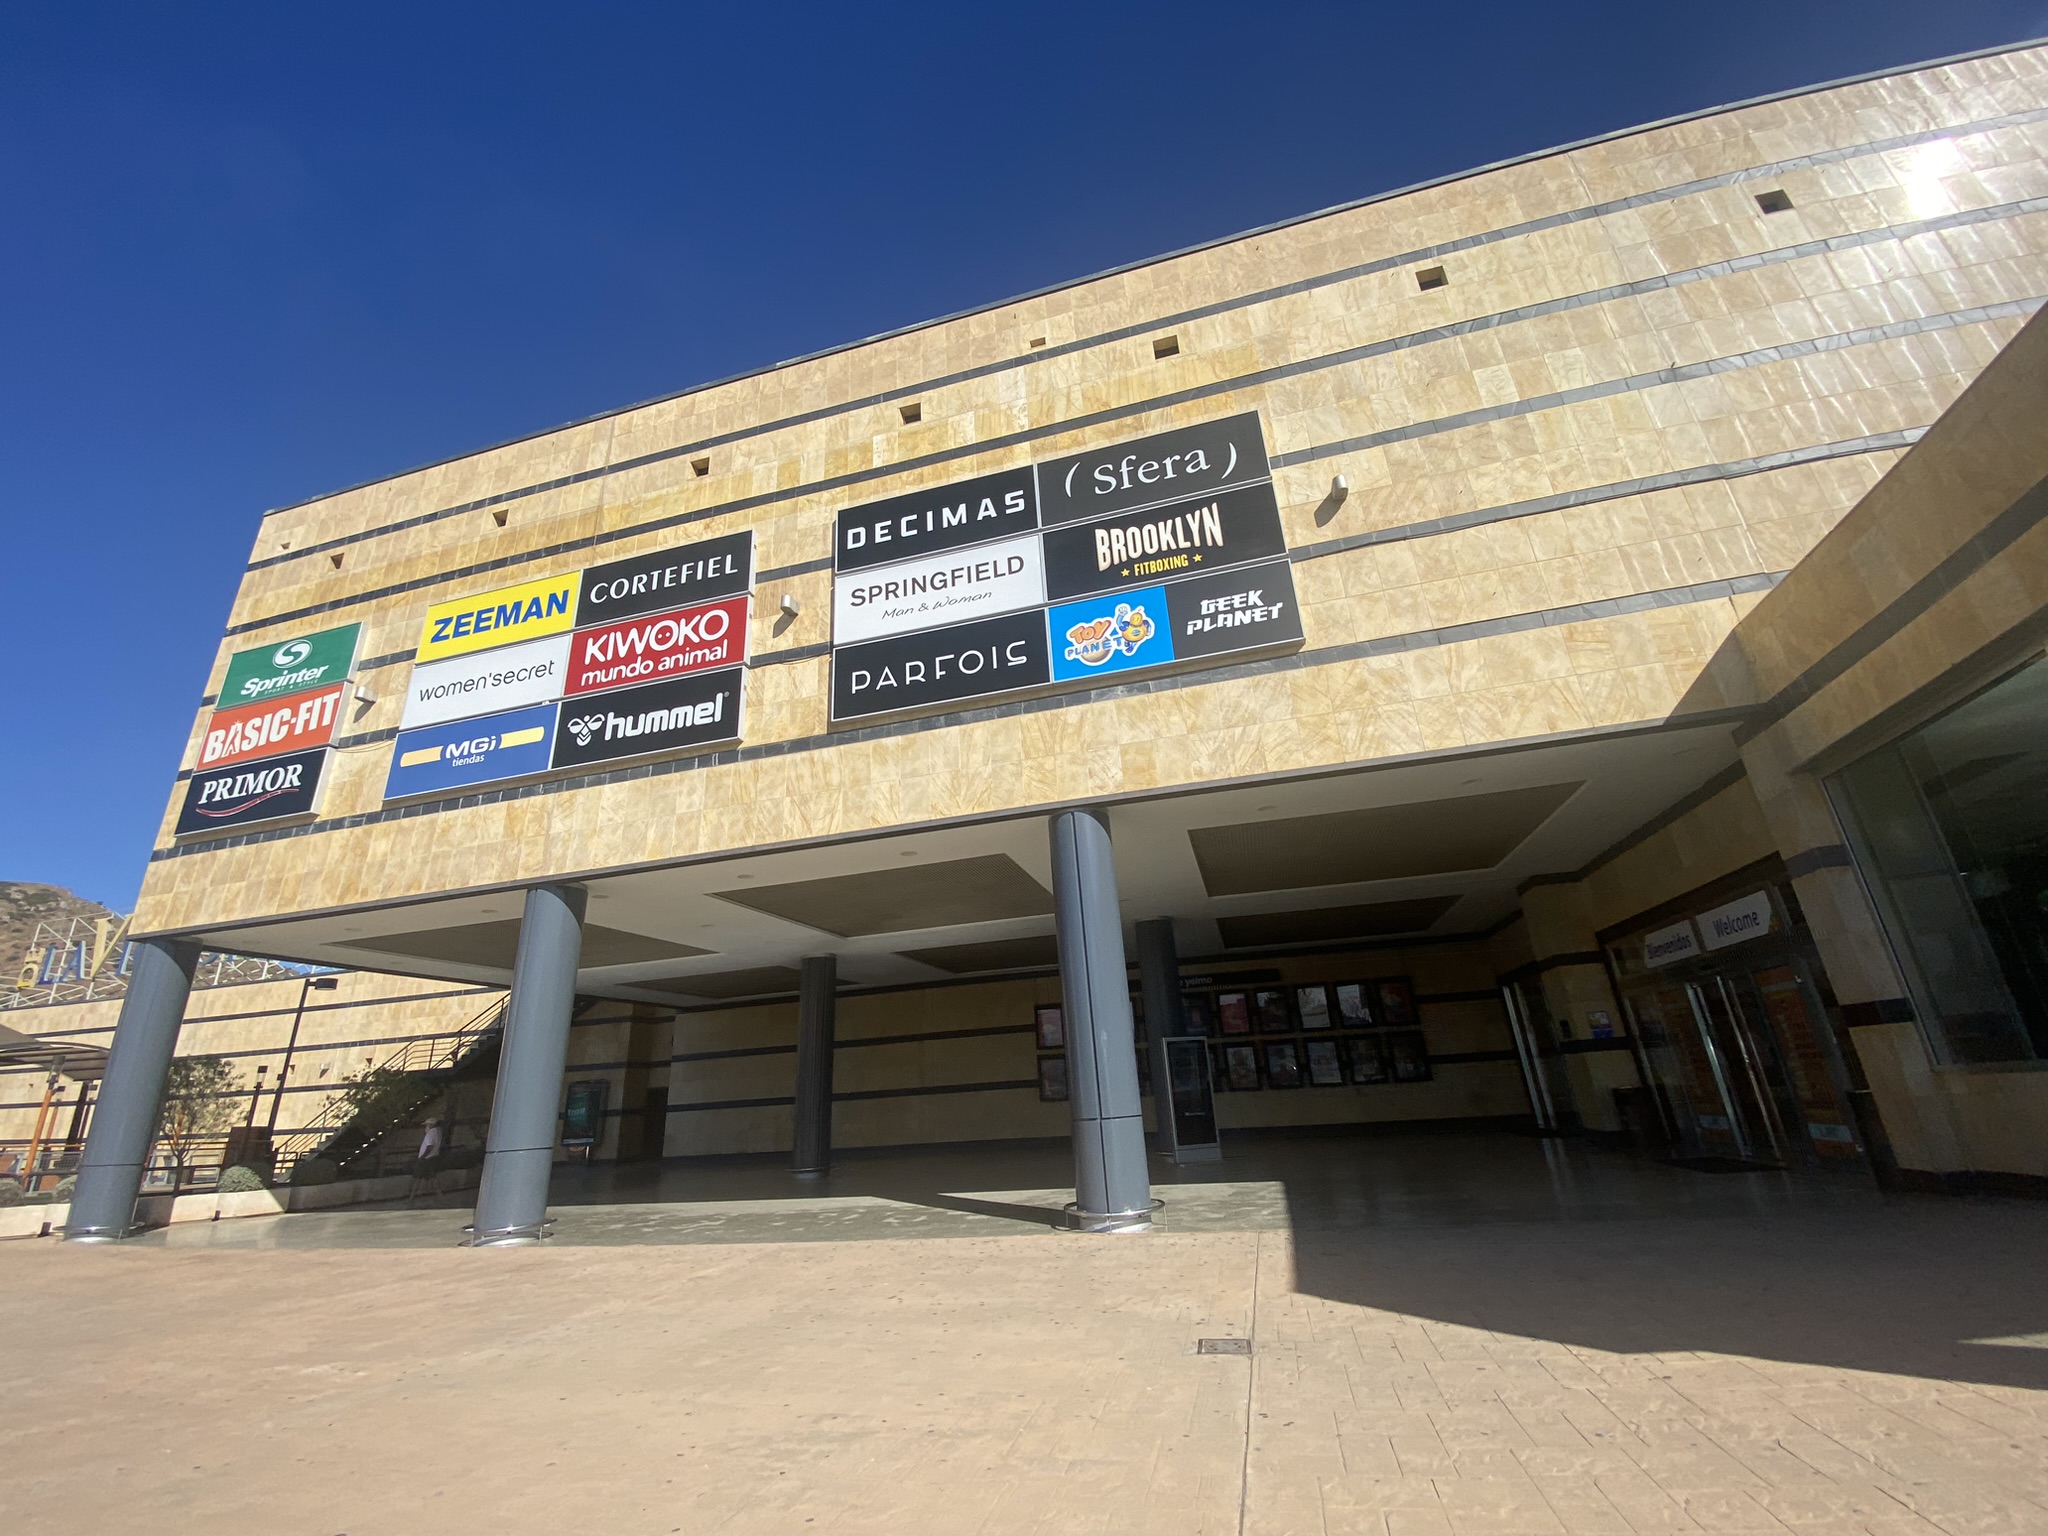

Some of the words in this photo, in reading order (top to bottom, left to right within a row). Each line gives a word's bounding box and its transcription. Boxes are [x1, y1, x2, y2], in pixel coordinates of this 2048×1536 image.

[846, 489, 1026, 551] DECIMAS
[1094, 501, 1225, 572] BROOKLYN
[589, 553, 738, 604] CORTEFIEL
[850, 554, 1025, 607] SPRINGFIELD
[1133, 553, 1189, 577] FITBOXING
[430, 589, 570, 644] ZEEMAN
[881, 605, 915, 621] Man
[932, 591, 993, 611] Woman
[1186, 601, 1284, 635] PLANET
[1200, 589, 1264, 615] GEEK
[584, 609, 730, 665] KIWOKO
[1067, 636, 1123, 658] PLANET
[240, 665, 330, 697] Sprinter
[419, 659, 555, 702] women'secret
[581, 659, 653, 687] mundo
[658, 639, 728, 672] animal
[851, 640, 1028, 695] PARFOIS
[202, 691, 341, 764] BASIC-FIT
[605, 692, 724, 741] hummel
[451, 752, 485, 768] tiendas
[198, 763, 303, 805] PRIMOR
[1712, 908, 1761, 939] Welcome
